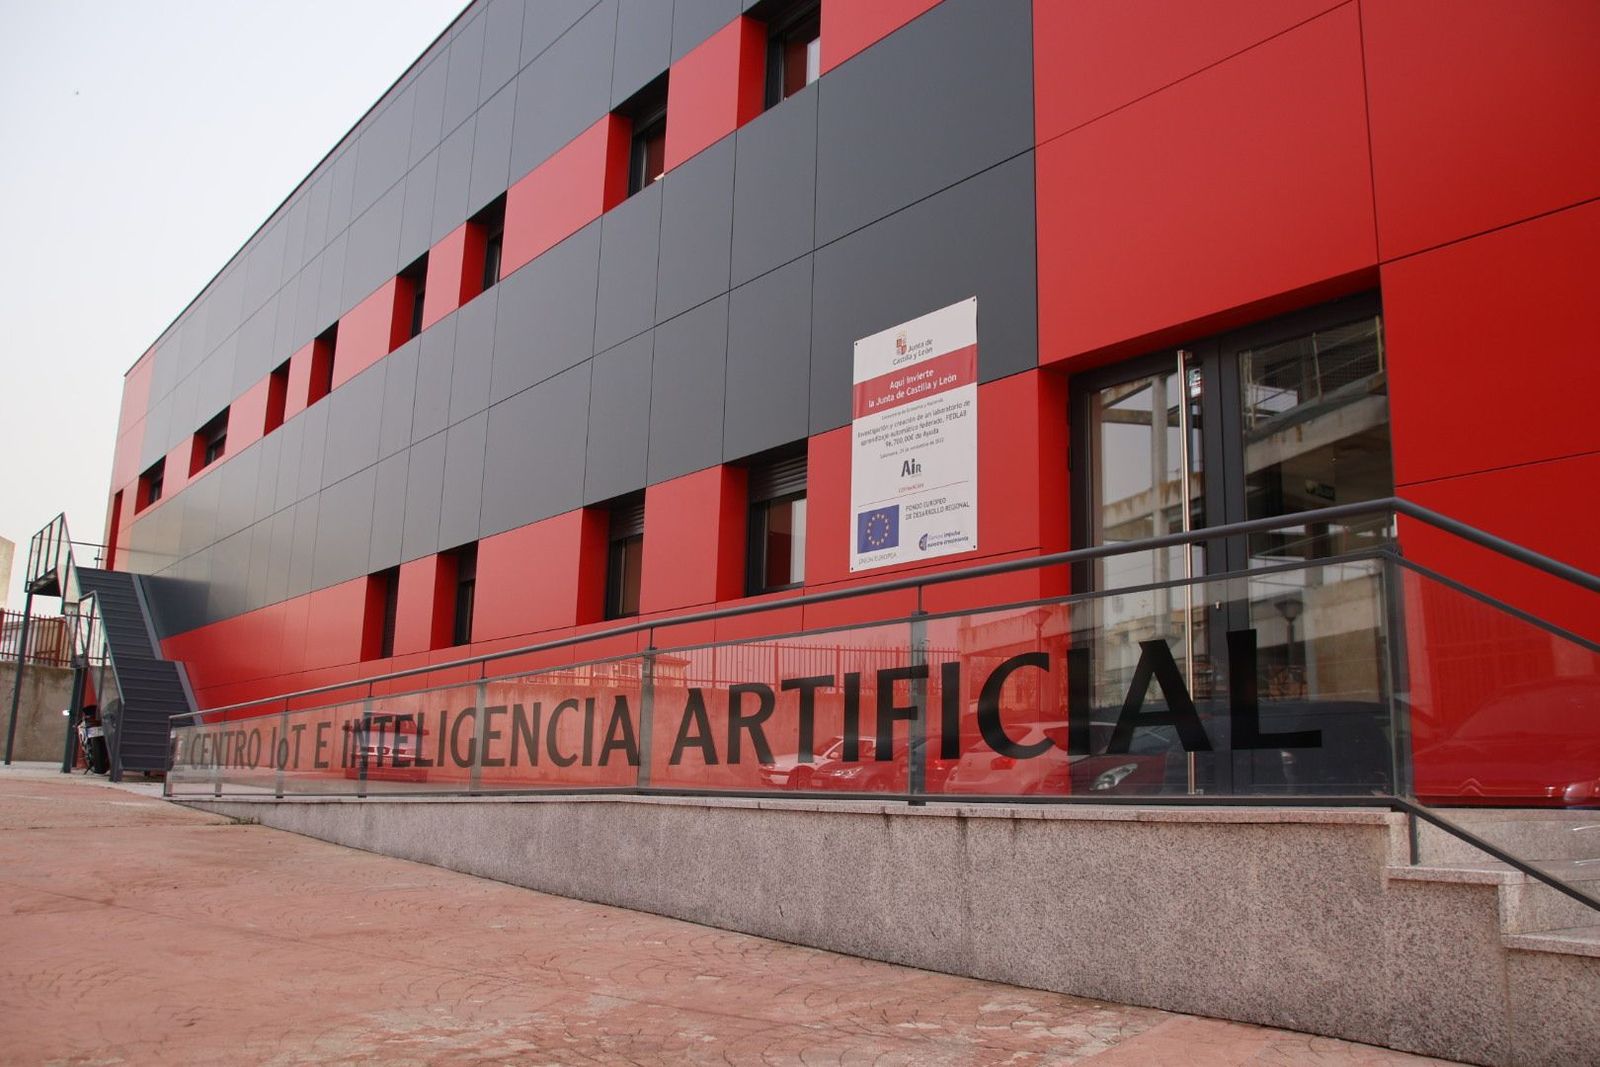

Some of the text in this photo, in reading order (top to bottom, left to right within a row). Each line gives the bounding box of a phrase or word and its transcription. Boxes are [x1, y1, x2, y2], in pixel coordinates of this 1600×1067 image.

[868, 373, 957, 408] la Junta de Castilla y León
[190, 728, 262, 770] CENTRO
[314, 721, 332, 768] E
[341, 695, 640, 769] INTELIGENCIA
[669, 629, 1323, 766] ARTIFICIAL
